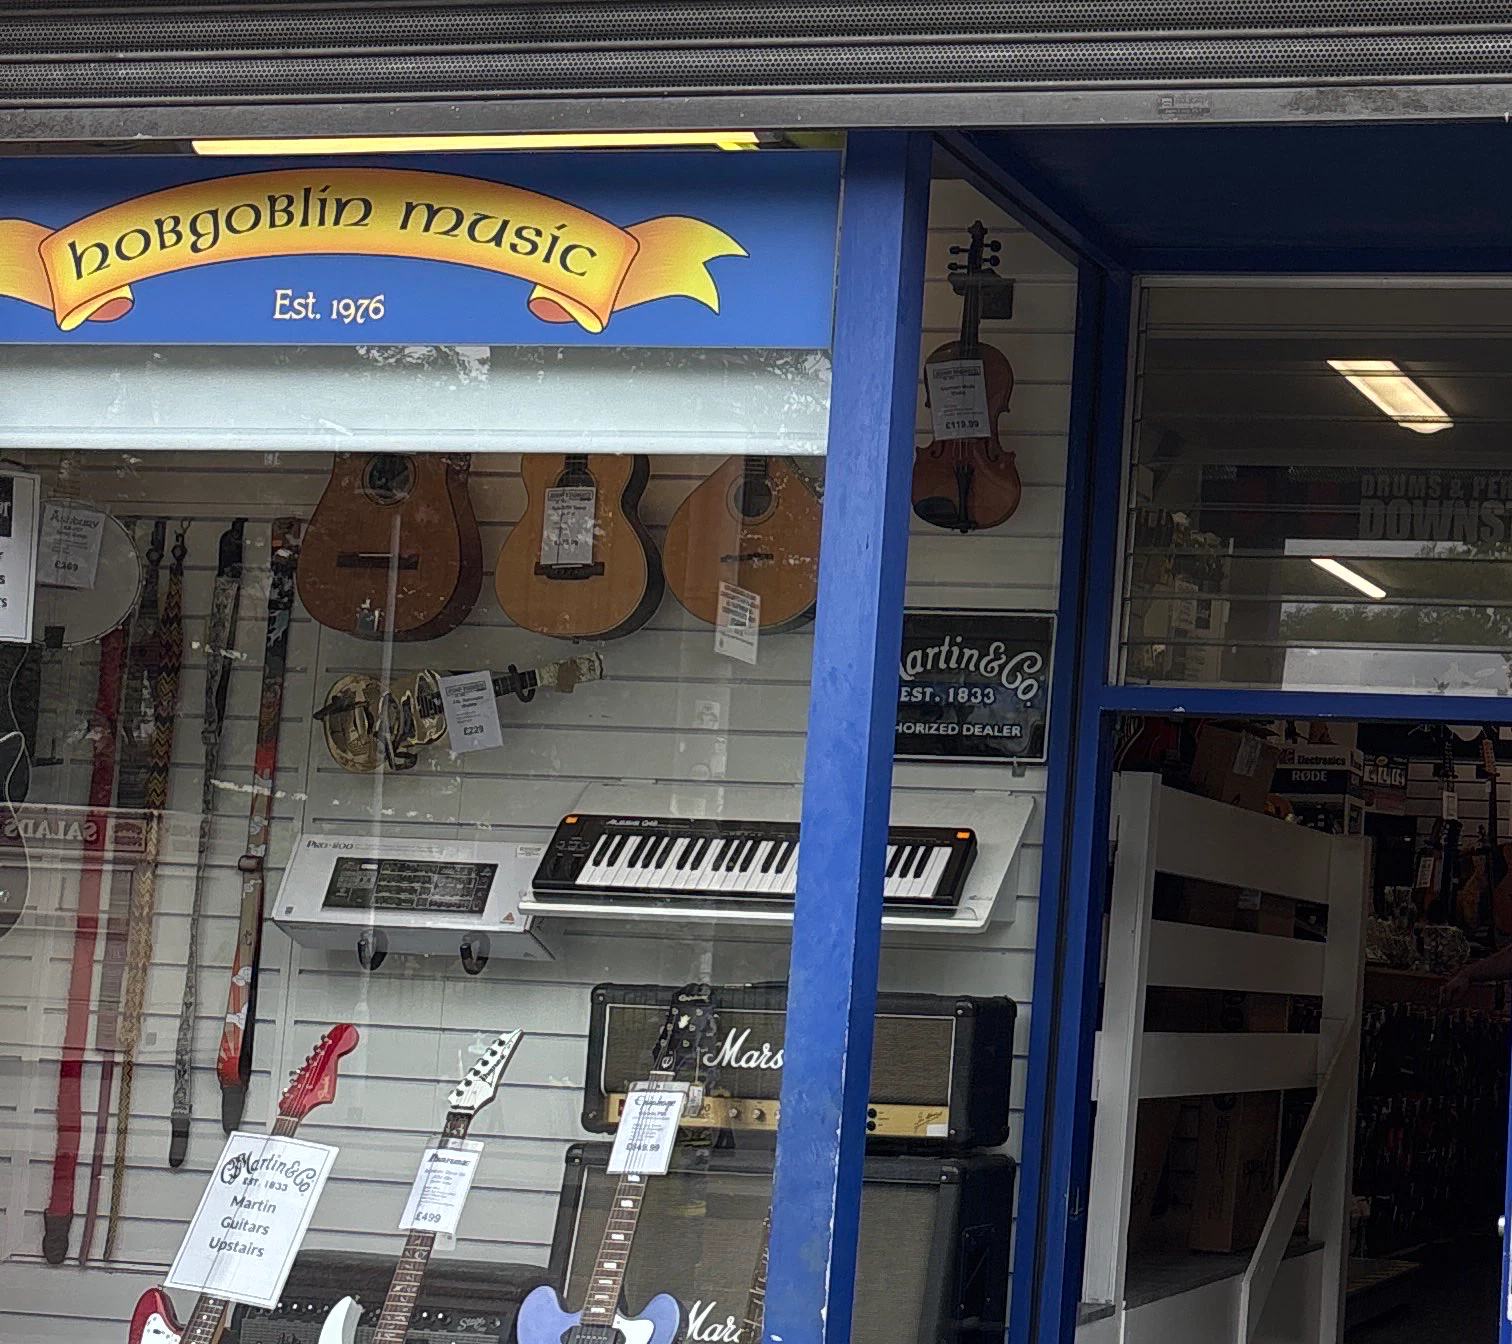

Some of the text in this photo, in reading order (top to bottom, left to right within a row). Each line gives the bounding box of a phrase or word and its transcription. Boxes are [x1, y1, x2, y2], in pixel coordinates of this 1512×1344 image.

[273, 289, 386, 325] Est. 1976
[1361, 474, 1442, 497] DRUMS
[948, 687, 995, 704] 1833
[962, 724, 1021, 737] DEALER
[230, 1195, 277, 1214] Martin
[221, 1216, 270, 1235] Guitars
[209, 1237, 265, 1258] Upstairs
